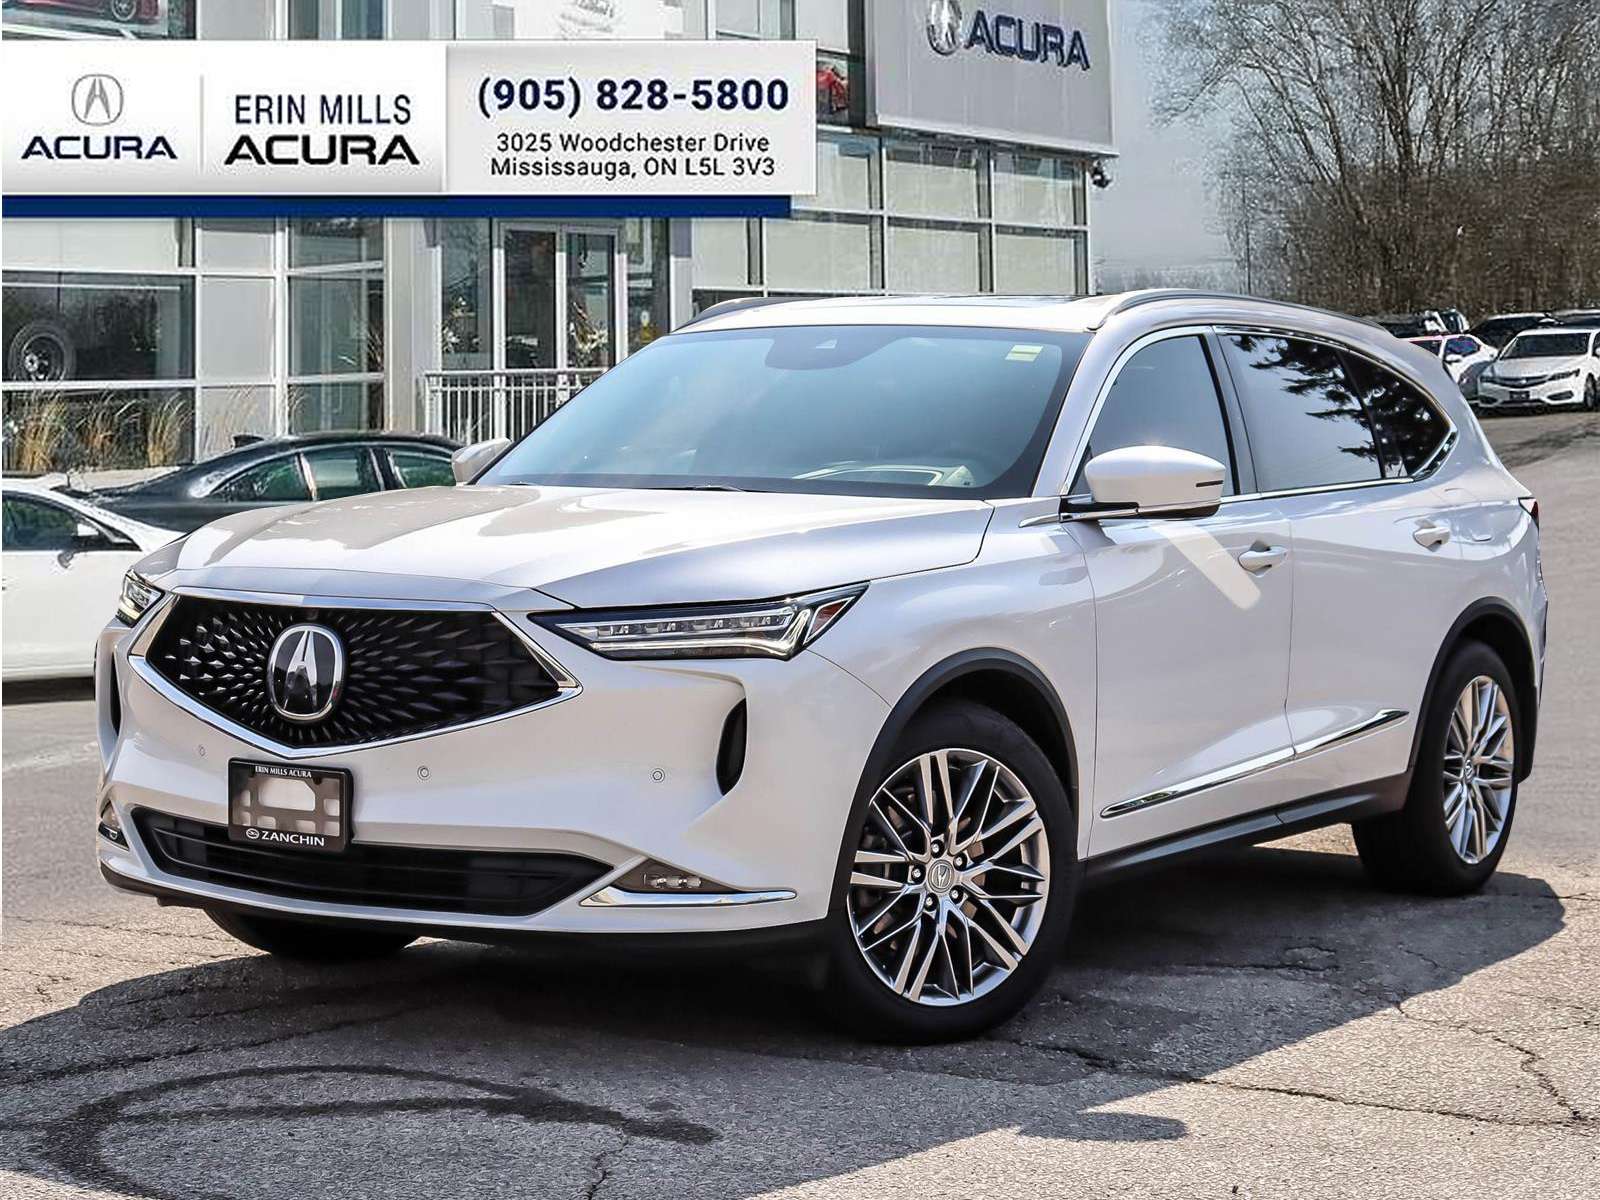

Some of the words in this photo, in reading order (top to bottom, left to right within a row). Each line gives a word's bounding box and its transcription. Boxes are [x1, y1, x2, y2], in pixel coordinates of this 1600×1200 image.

[964, 10, 1091, 71] ACURA
[255, 765, 270, 774] ERIN
[270, 766, 288, 776] MILLS
[288, 769, 312, 779] ACURA
[261, 830, 326, 847] ZANCHIN
